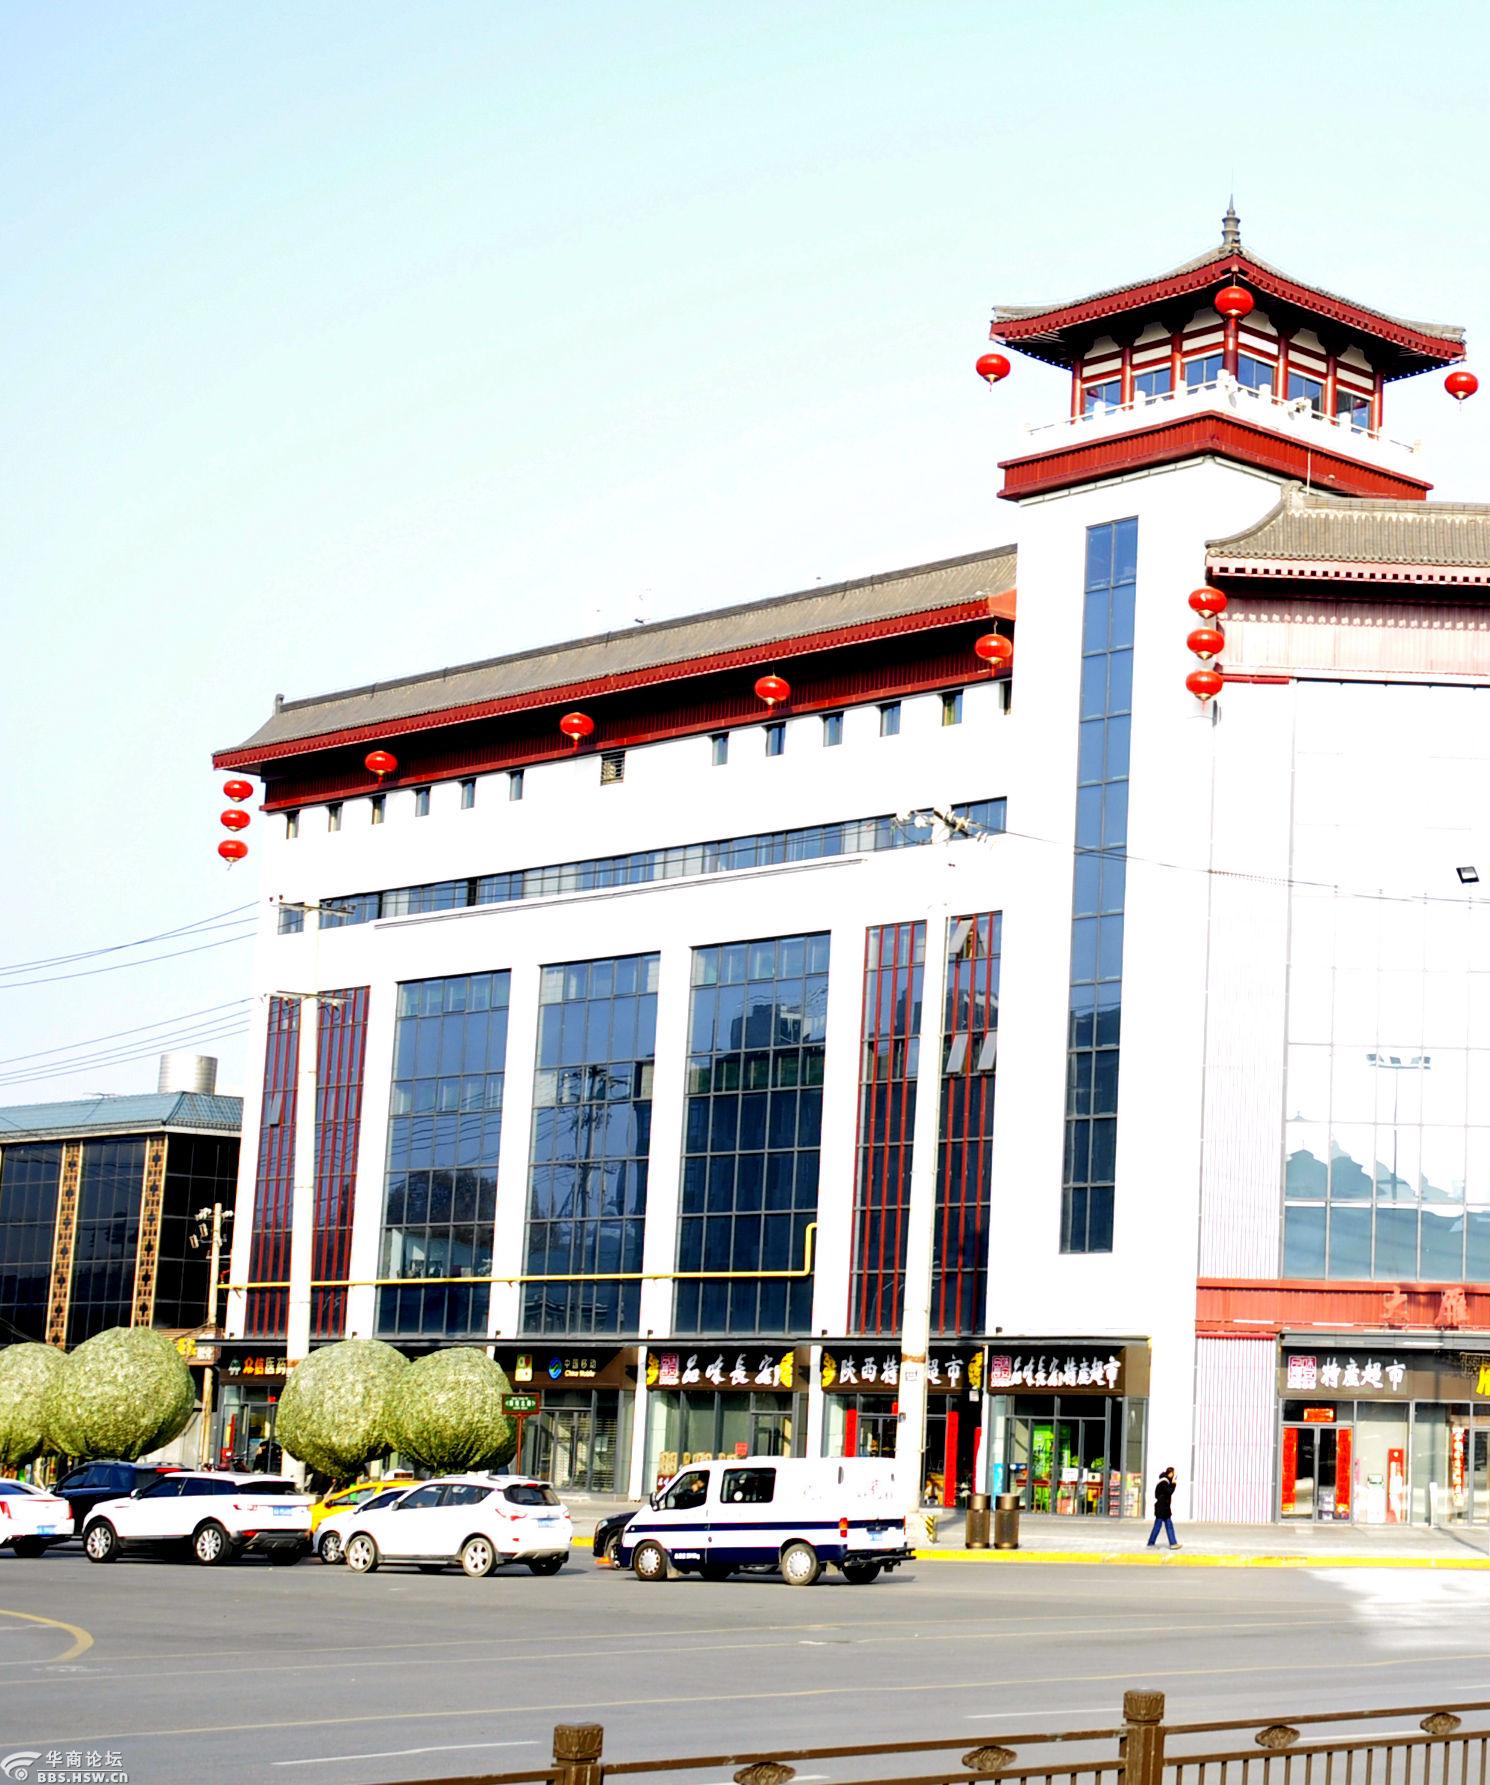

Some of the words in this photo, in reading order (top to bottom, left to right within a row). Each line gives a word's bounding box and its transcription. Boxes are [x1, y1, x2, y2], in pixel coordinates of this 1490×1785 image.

[839, 1354, 964, 1387] 陕西特超市
